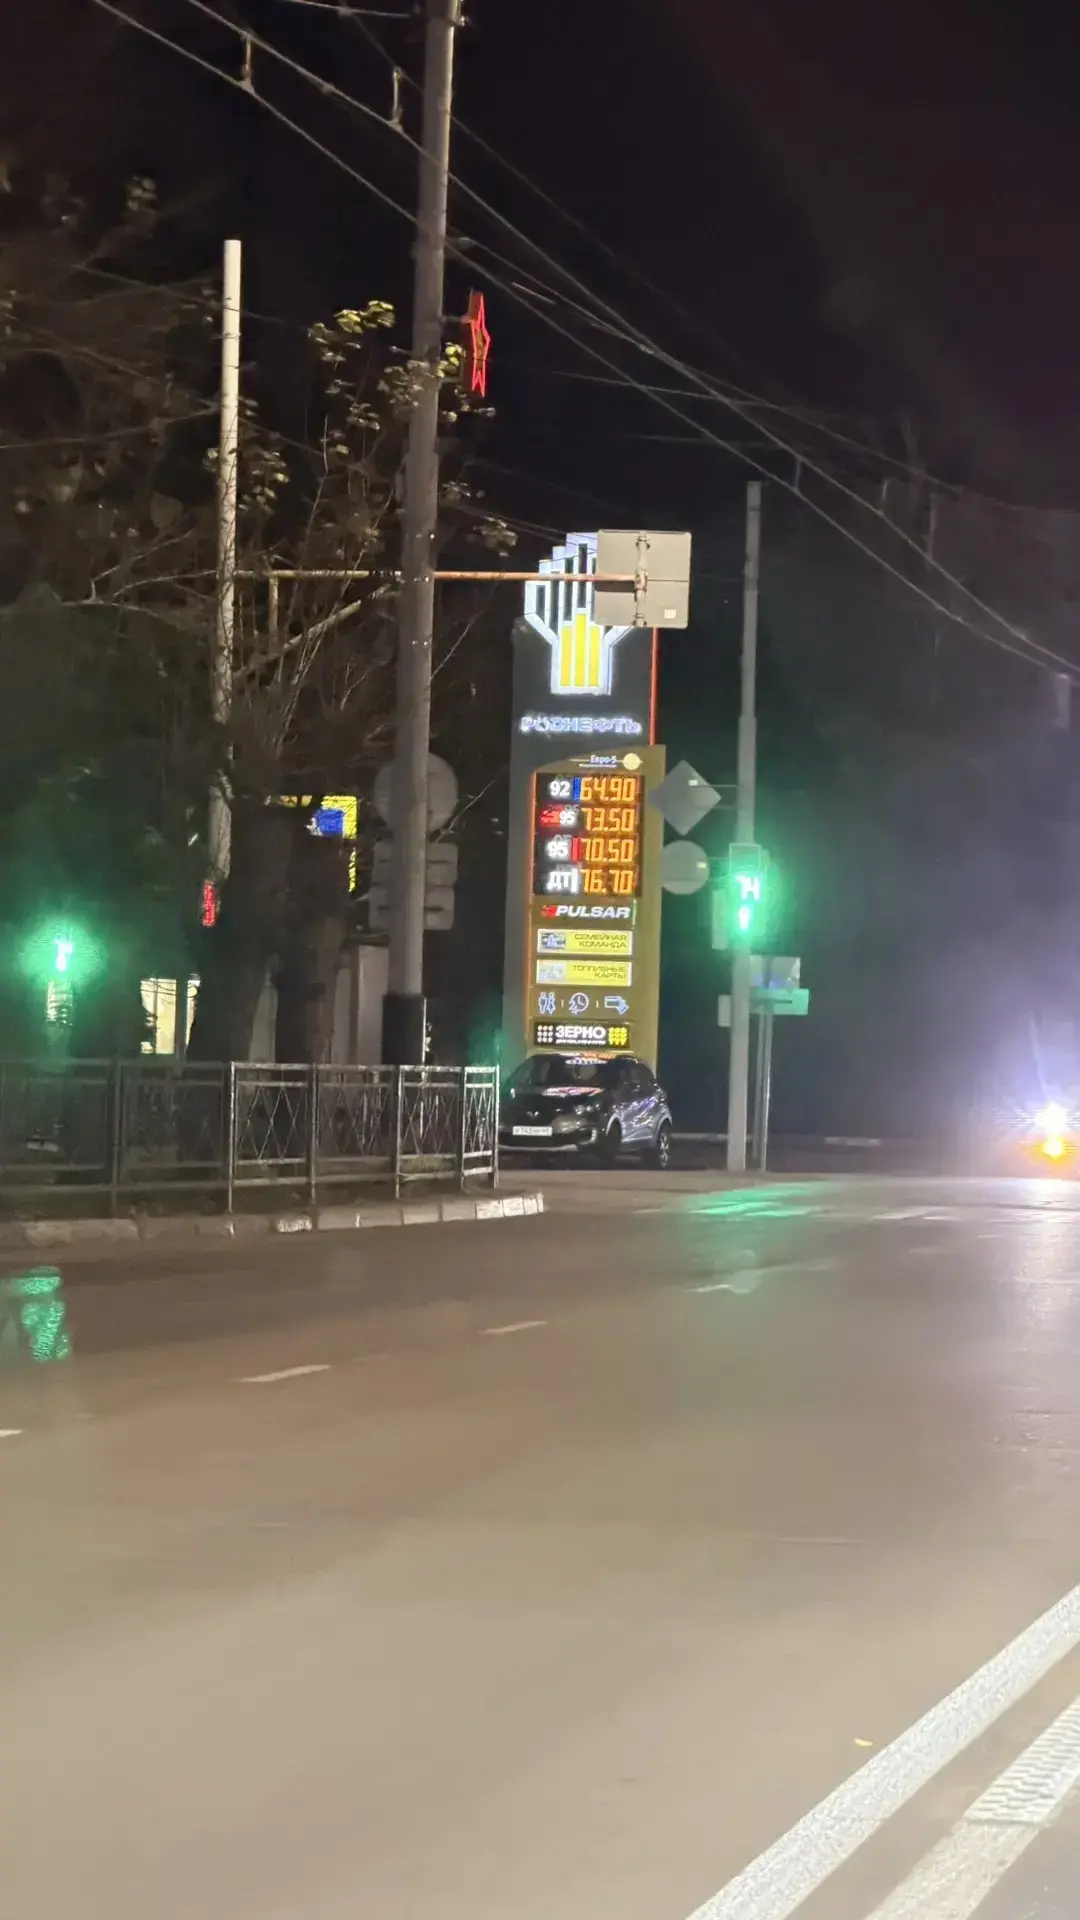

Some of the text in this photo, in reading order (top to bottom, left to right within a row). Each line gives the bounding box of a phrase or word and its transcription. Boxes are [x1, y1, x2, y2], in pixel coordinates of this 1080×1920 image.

[520, 716, 642, 733] РОСНЕФТЬ
[550, 778, 636, 801] 92 64.90
[559, 807, 635, 831] 95 73.50
[547, 838, 635, 862] 95 70.50
[580, 869, 634, 893] 76.70
[554, 905, 631, 919] PULSAR
[574, 933, 628, 941] СЕМЕЙНАЯ
[579, 941, 627, 949] КОМАНДА
[594, 972, 627, 980] КАРТЫ
[555, 1025, 606, 1039] ЗЕРНО
